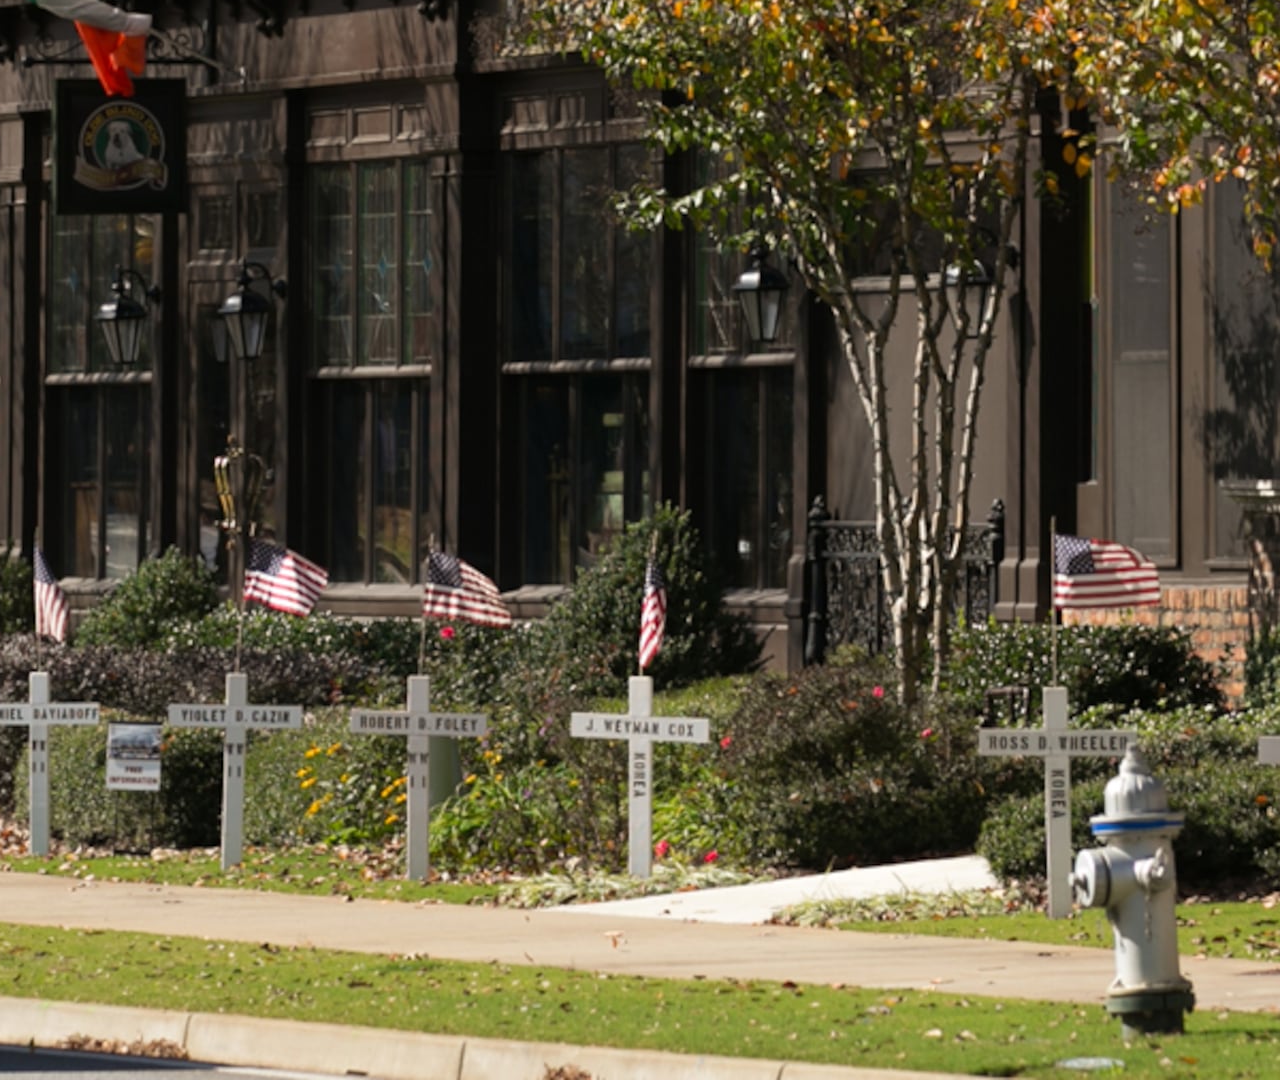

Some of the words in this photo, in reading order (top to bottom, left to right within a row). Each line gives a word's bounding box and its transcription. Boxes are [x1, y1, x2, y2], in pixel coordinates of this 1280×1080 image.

[181, 710, 226, 722] VIOLET
[360, 716, 410, 729] ROBERT
[436, 717, 478, 731] FOLEY
[604, 719, 660, 733] WEYMAN
[668, 723, 694, 735] COX
[989, 736, 1028, 750] ROSS
[633, 752, 647, 798] KOREA
[1050, 770, 1066, 819] KOREA
